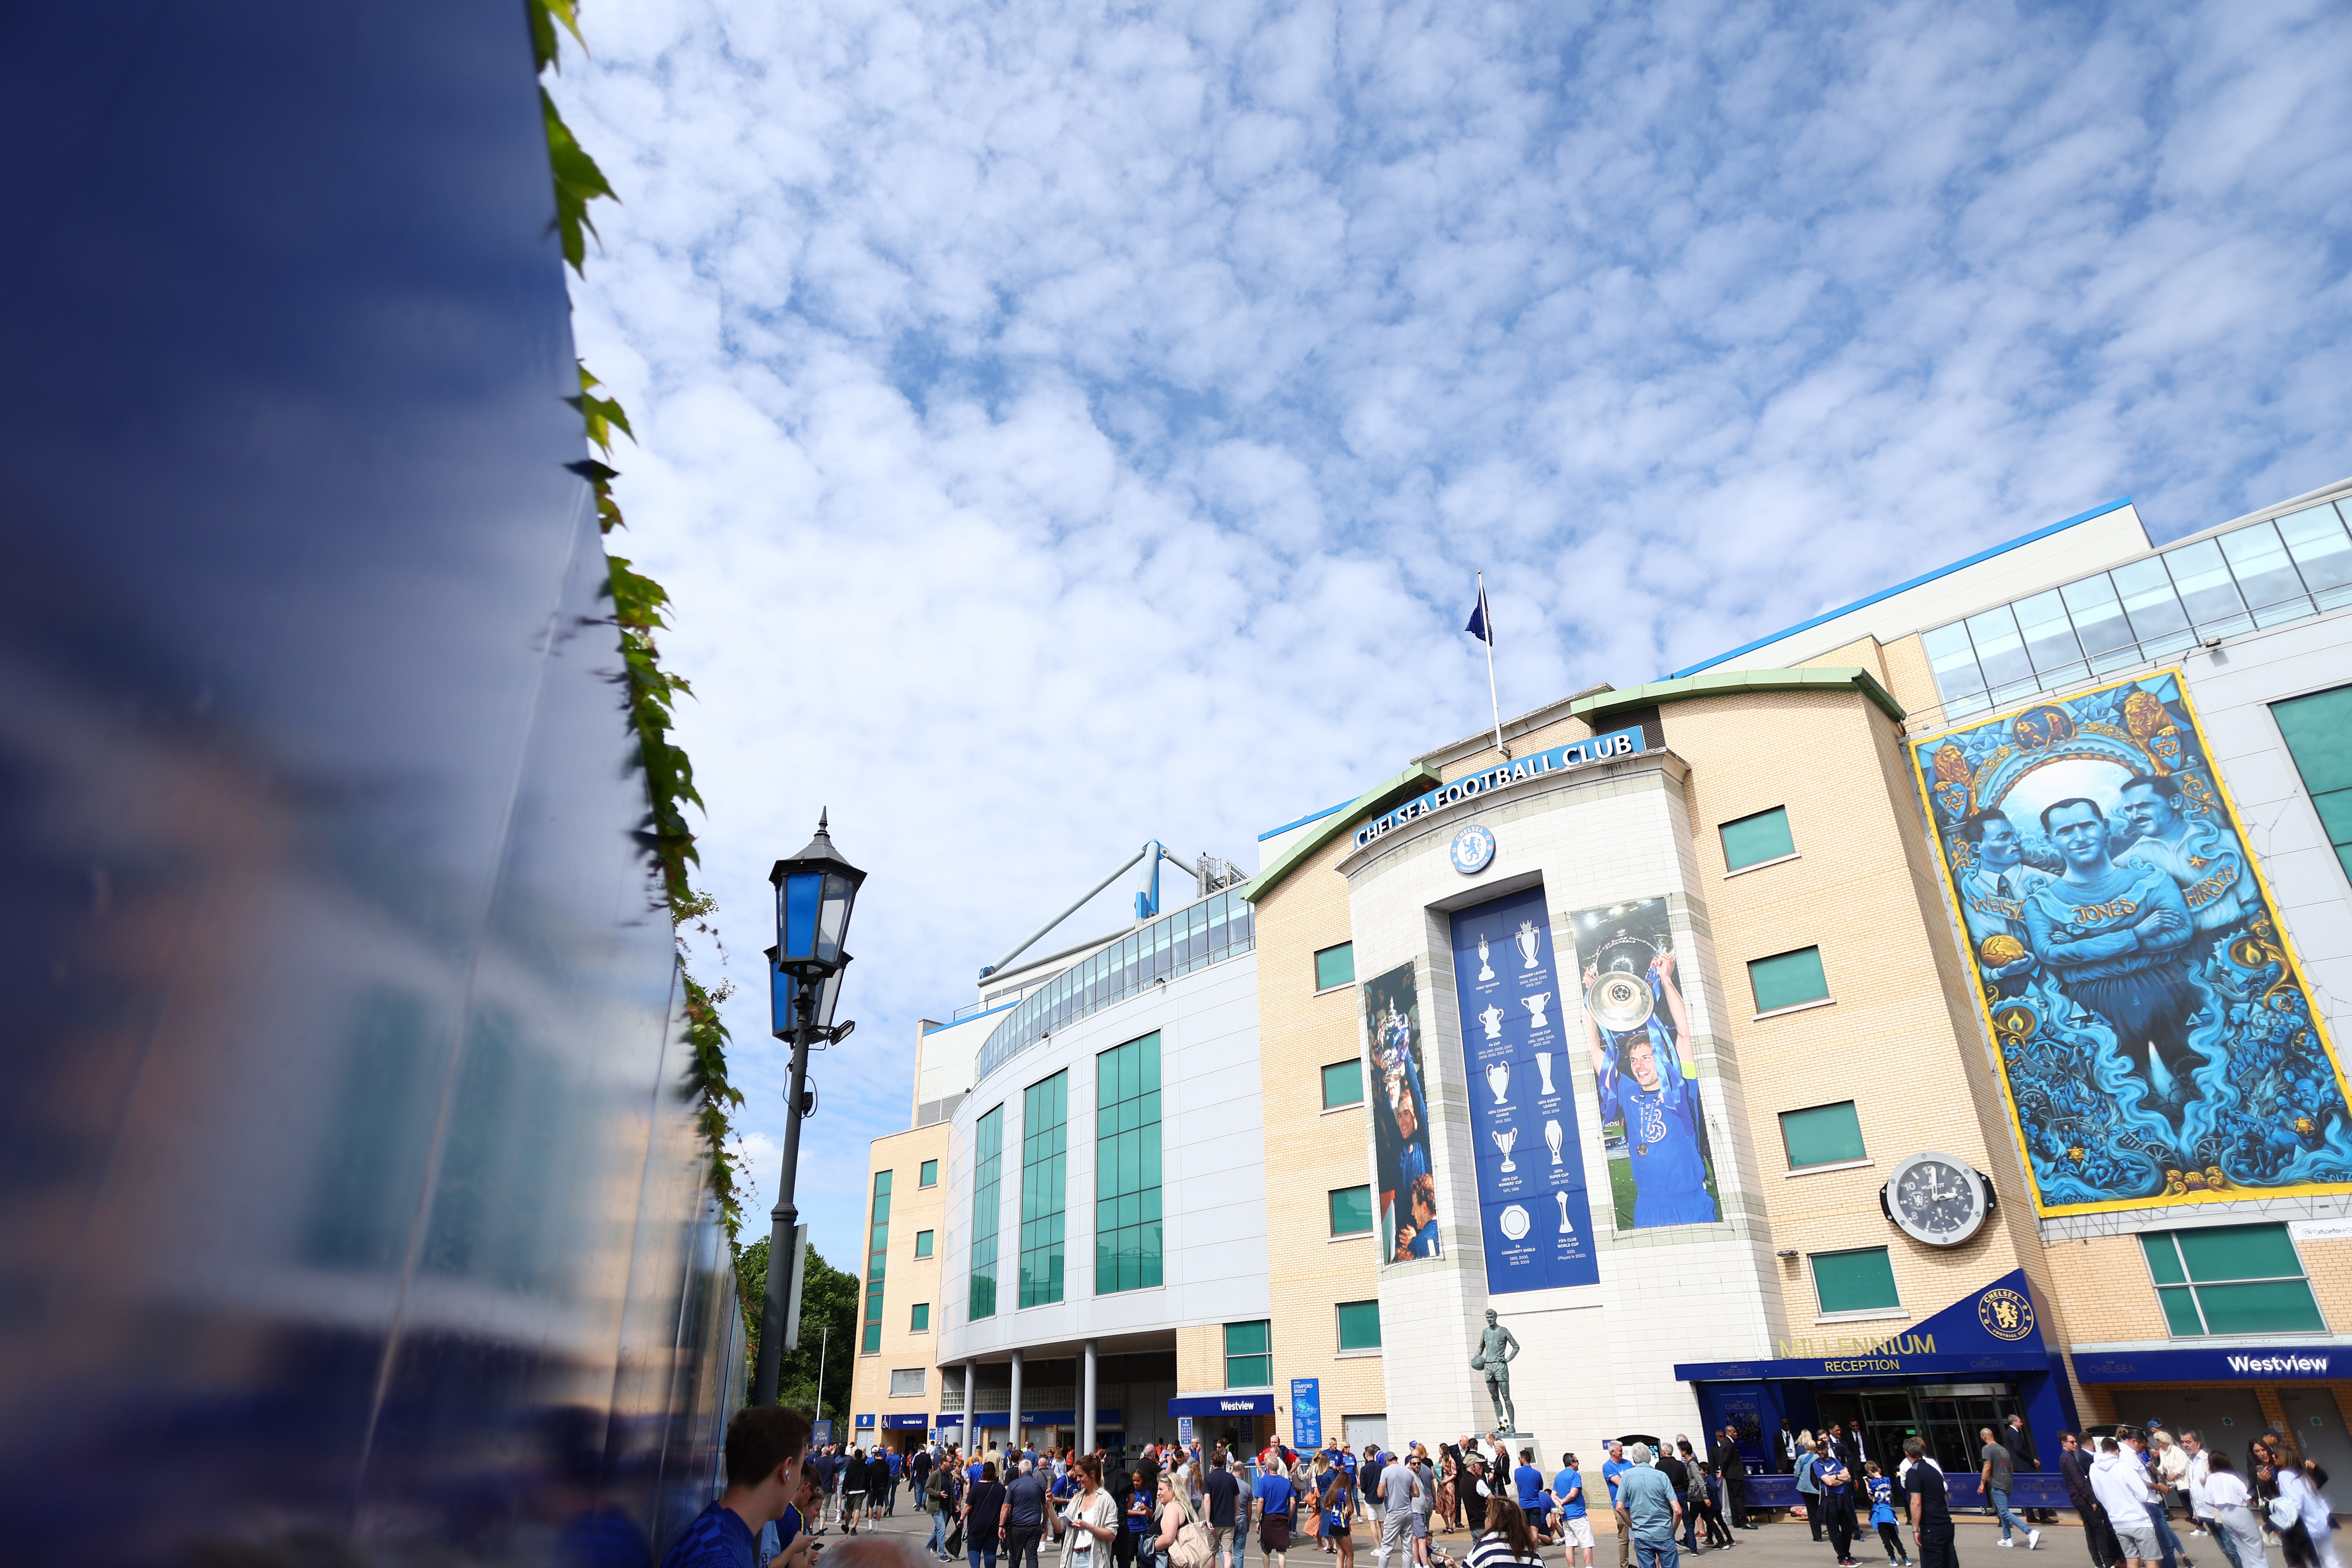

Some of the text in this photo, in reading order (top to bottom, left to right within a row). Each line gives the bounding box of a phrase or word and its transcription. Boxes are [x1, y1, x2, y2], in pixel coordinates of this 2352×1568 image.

[1356, 735, 1632, 848] CHELSEA FOOTBALL CLUB
[1456, 826, 1483, 842] CHELSEA
[1479, 856, 1488, 866] CLUB
[2181, 864, 2238, 907] HIRSCH
[1970, 892, 2026, 921] WEISZ
[2071, 898, 2137, 924] JONES
[1904, 1181, 1916, 1191] 10
[1954, 1176, 1963, 1185] 2
[2044, 1196, 2096, 1206] SOLOMON
[1984, 1291, 2018, 1303] CHELSEA
[1993, 1327, 2028, 1338] FOOTBALL CLUB
[1779, 1334, 1937, 1359] MILLENNIUM
[1824, 1359, 1900, 1372] RECEPTION
[2227, 1355, 2327, 1372] Westview
[1717, 1368, 1753, 1376] CHELSEA
[2089, 1365, 2136, 1374] CHELSEA
[1220, 1401, 1254, 1411] Westview
[2022, 1483, 2063, 1491] CHELSEA
